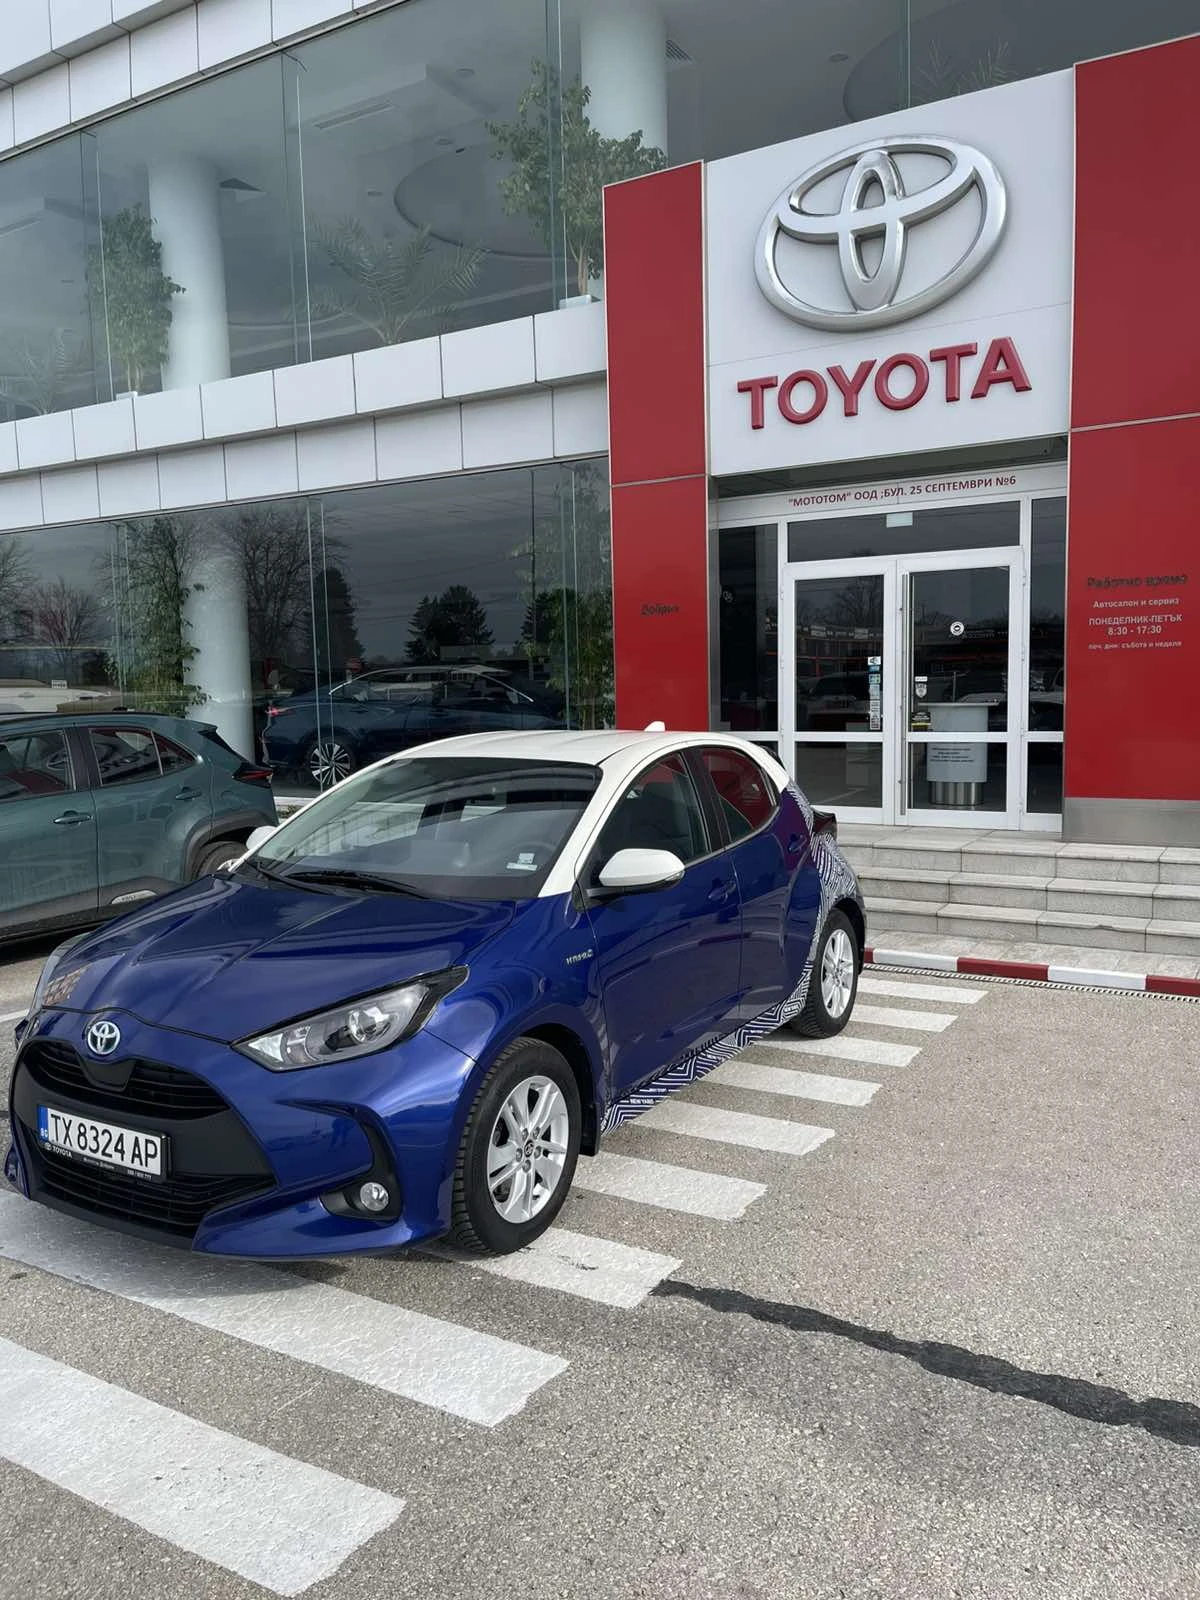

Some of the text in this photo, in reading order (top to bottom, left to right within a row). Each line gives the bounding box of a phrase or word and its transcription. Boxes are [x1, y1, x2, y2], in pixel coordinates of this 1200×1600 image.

[737, 336, 1032, 430] TOYOTA
[854, 490, 878, 500] ООД
[910, 485, 922, 495] 25
[925, 478, 992, 494] СЕПТЕМВРИ
[996, 475, 1016, 486] №6
[1093, 600, 1139, 609] Автосалон
[1088, 614, 1183, 626] ПОНЕДЕЛНИК-ПЕТЪК
[1107, 626, 1127, 635] 8:30
[1137, 625, 1162, 634] 17:30
[50, 1113, 73, 1147] TX
[77, 1122, 126, 1162] 8324
[131, 1135, 158, 1168] AP
